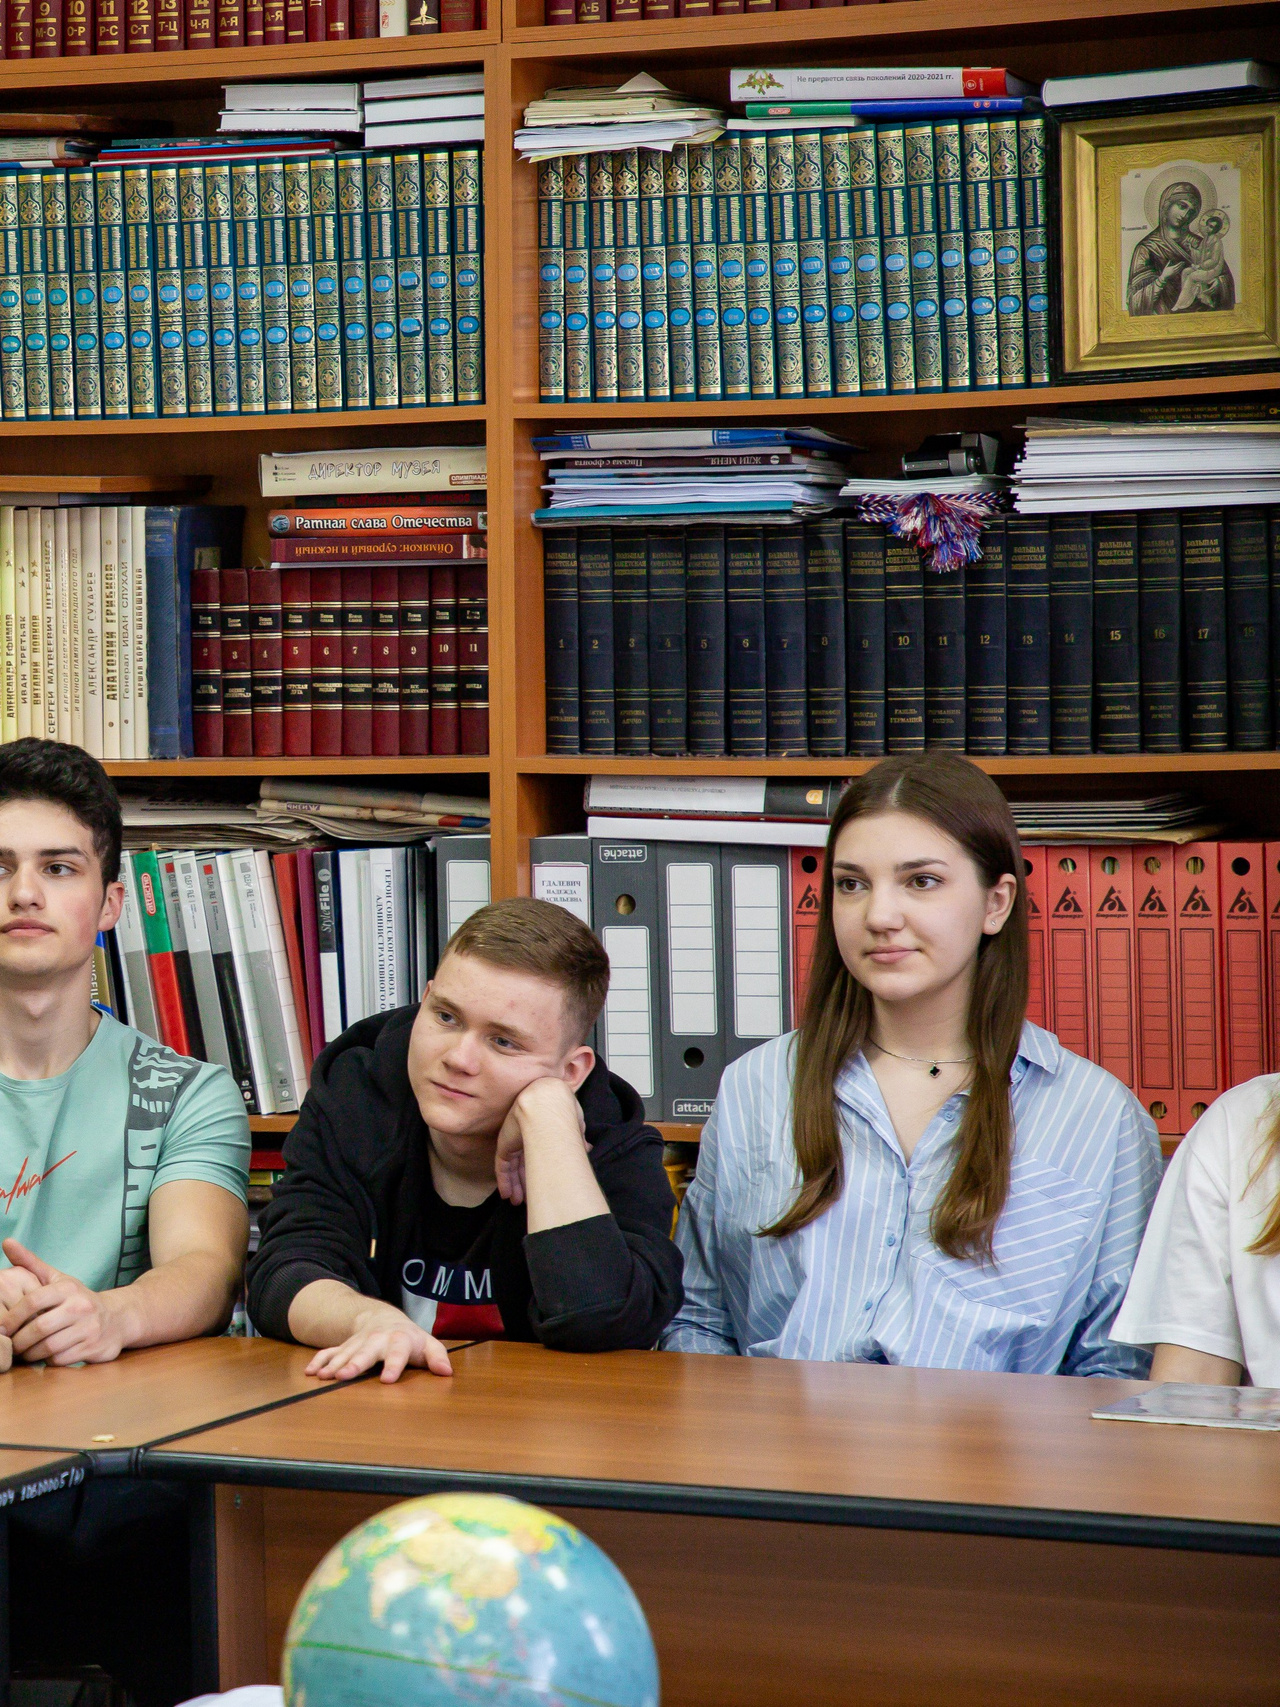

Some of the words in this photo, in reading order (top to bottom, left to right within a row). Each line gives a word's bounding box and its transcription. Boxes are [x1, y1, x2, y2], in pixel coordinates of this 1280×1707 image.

[15, 6, 25, 20] 7
[40, 2, 50, 16] 9
[69, 1, 86, 15] 10
[101, 1, 115, 15] 11
[160, 21, 178, 33] Т-Ц
[190, 18, 210, 29] Ч-Я
[866, 74, 905, 82] поколений
[308, 462, 383, 480] ДИРЕКТОР
[392, 459, 441, 479] МУЗЕЯ
[295, 517, 346, 531] Ратная
[351, 517, 387, 530] слава
[392, 516, 473, 529] Отечества
[295, 545, 339, 557] нежный
[342, 546, 348, 554] и
[351, 545, 397, 557] суровый
[400, 543, 454, 555] Оймякон:
[980, 635, 990, 644] 12
[1110, 630, 1121, 640] 15
[1197, 628, 1209, 639] 17
[898, 636, 909, 646] 10
[439, 643, 449, 654] 10
[469, 643, 479, 653] 11
[384, 869, 393, 899] ГЕРОИ
[386, 900, 394, 963] СОВЕТСКОГО
[376, 895, 386, 1001] АДМИНИСТРАТИВНОГО
[402, 1258, 492, 1300] OMM
